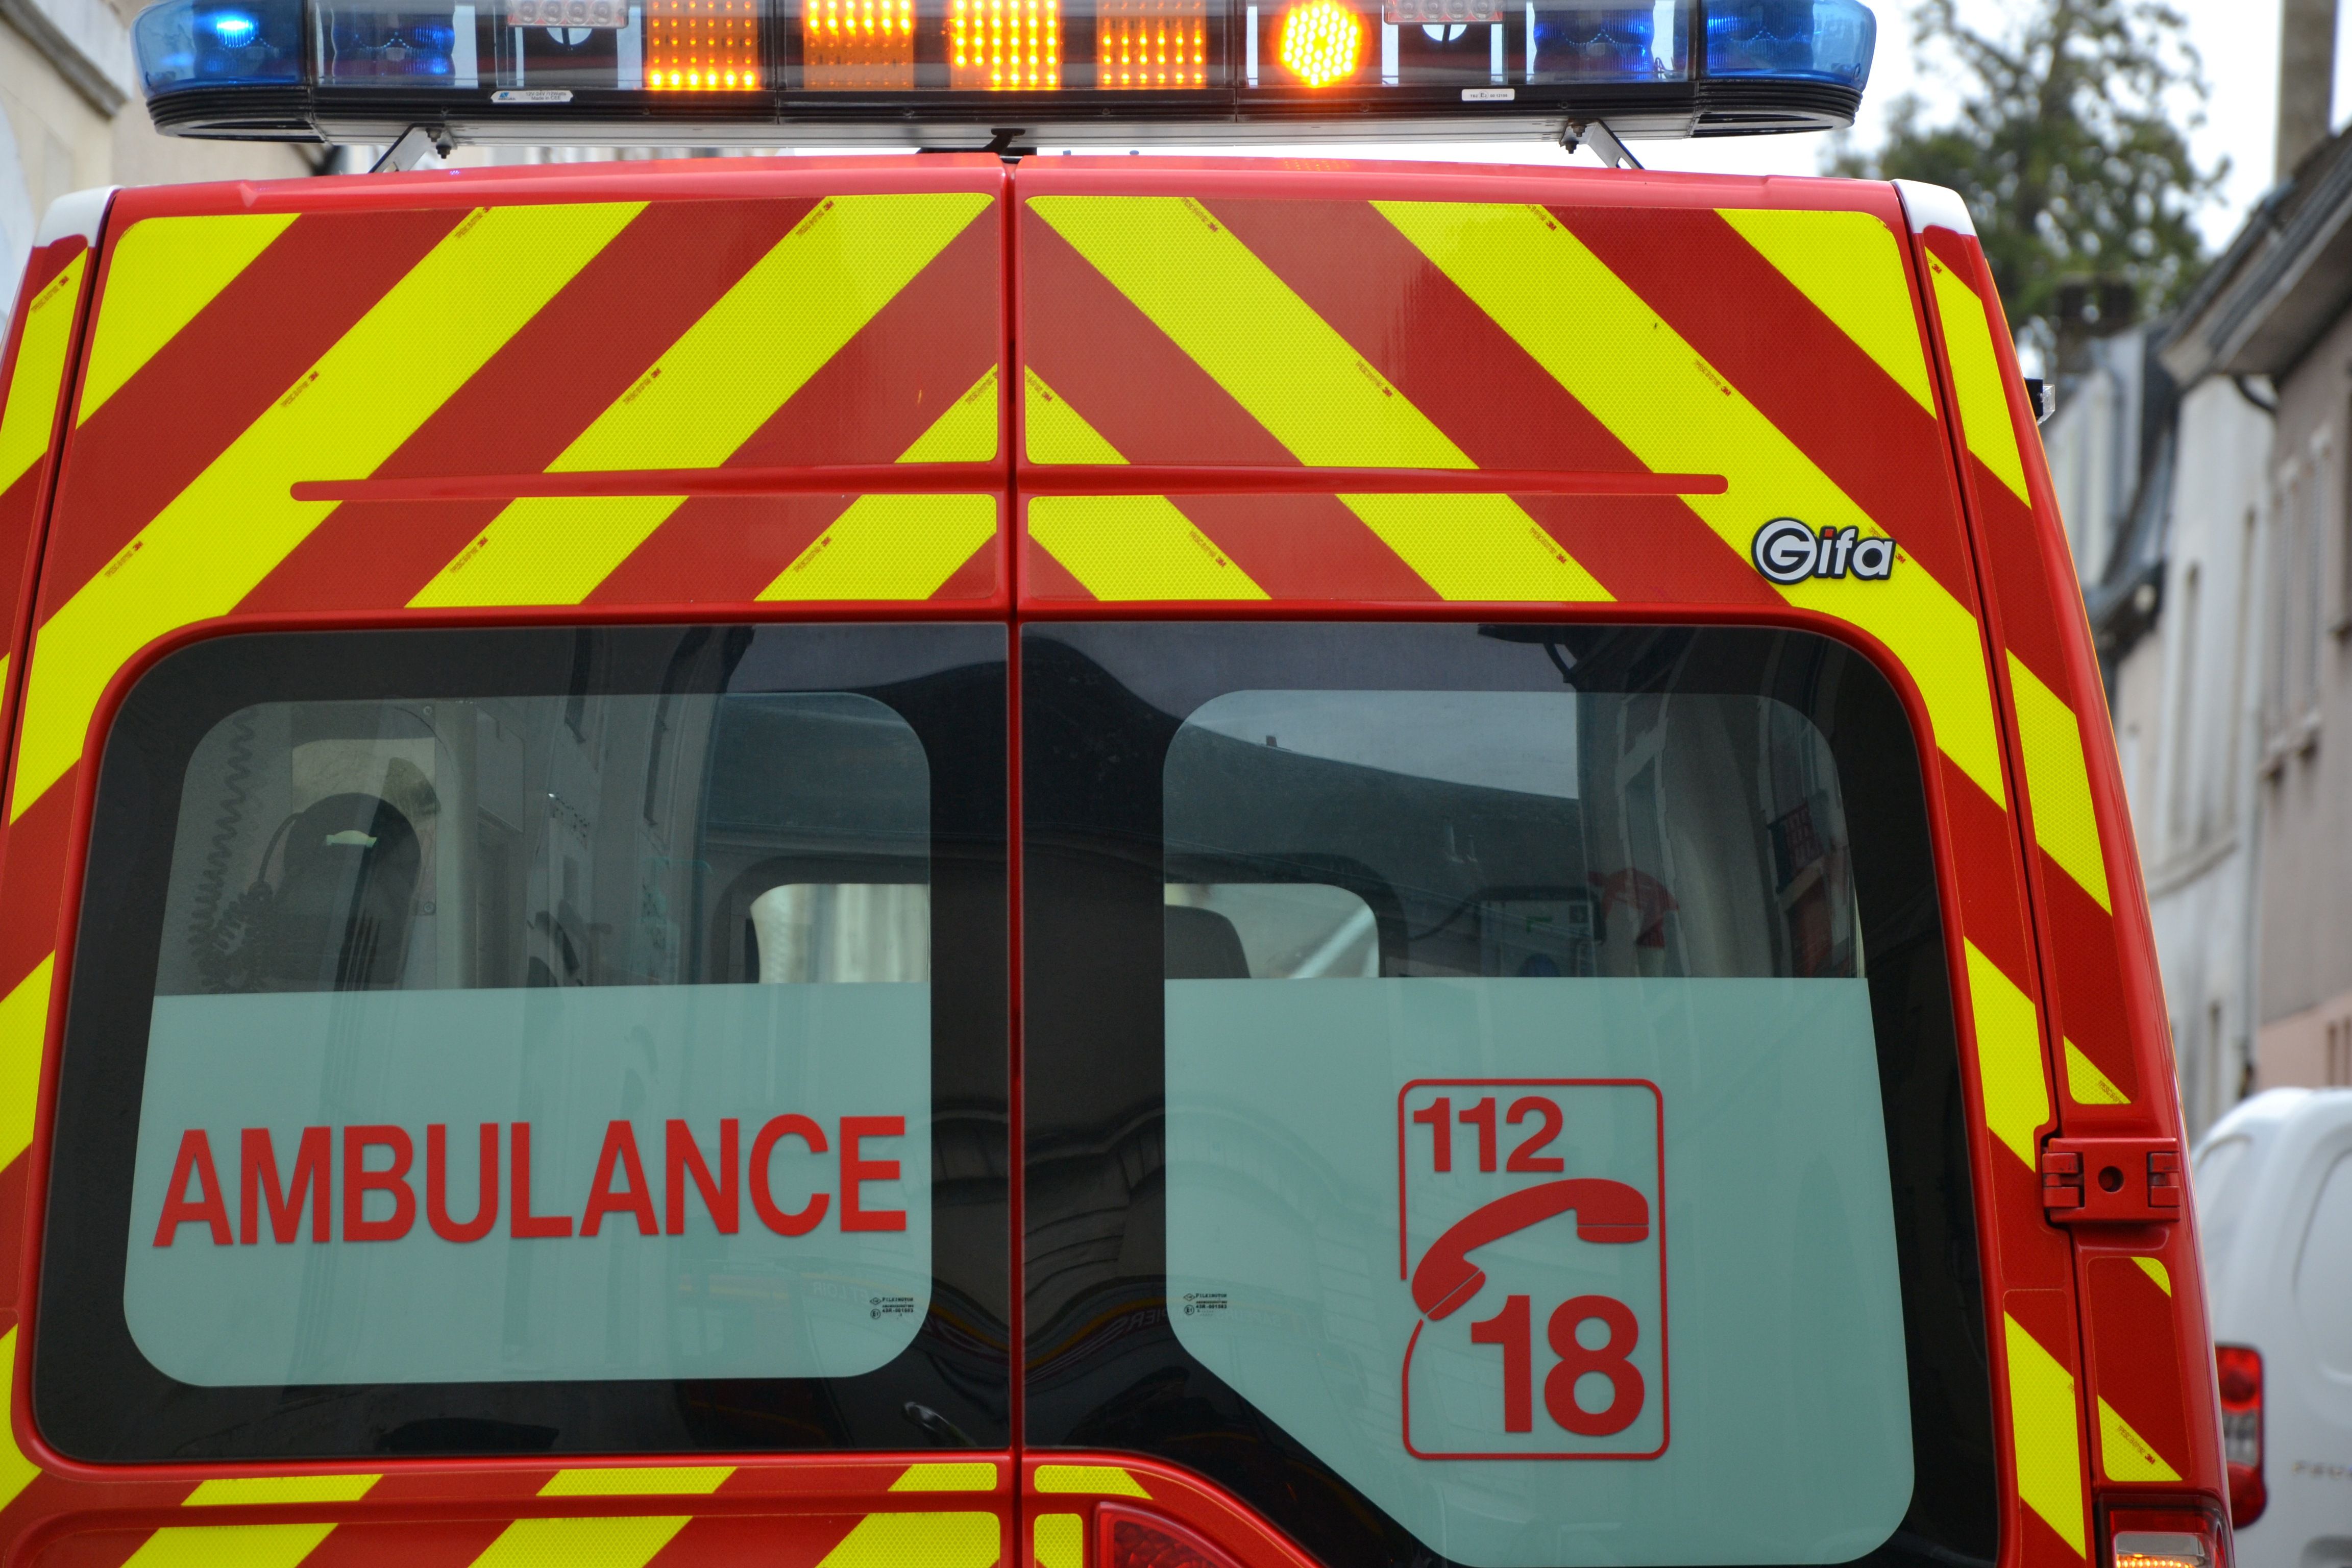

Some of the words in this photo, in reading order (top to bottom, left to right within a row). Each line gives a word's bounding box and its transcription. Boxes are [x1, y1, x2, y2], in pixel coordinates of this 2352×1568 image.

[823, 200, 835, 211] 3M
[1207, 222, 1218, 232] 3M
[1546, 220, 1557, 231] 3M
[1931, 263, 1942, 274] 3M
[58, 275, 69, 286] 3M
[308, 371, 319, 382] 3M
[650, 368, 662, 379] 3M
[1381, 386, 1393, 397] 3M
[1720, 385, 1731, 397] 3M
[132, 540, 143, 552] 3M
[820, 535, 831, 547] 3M
[1752, 518, 1896, 584] Gifa
[1555, 553, 1566, 564] 3M
[1895, 553, 1906, 564] 3M
[1413, 1096, 1564, 1172] 112
[153, 1114, 908, 1247] AMBULANCE
[1471, 1295, 1645, 1436] 18
[2144, 1453, 2155, 1464] 3M
